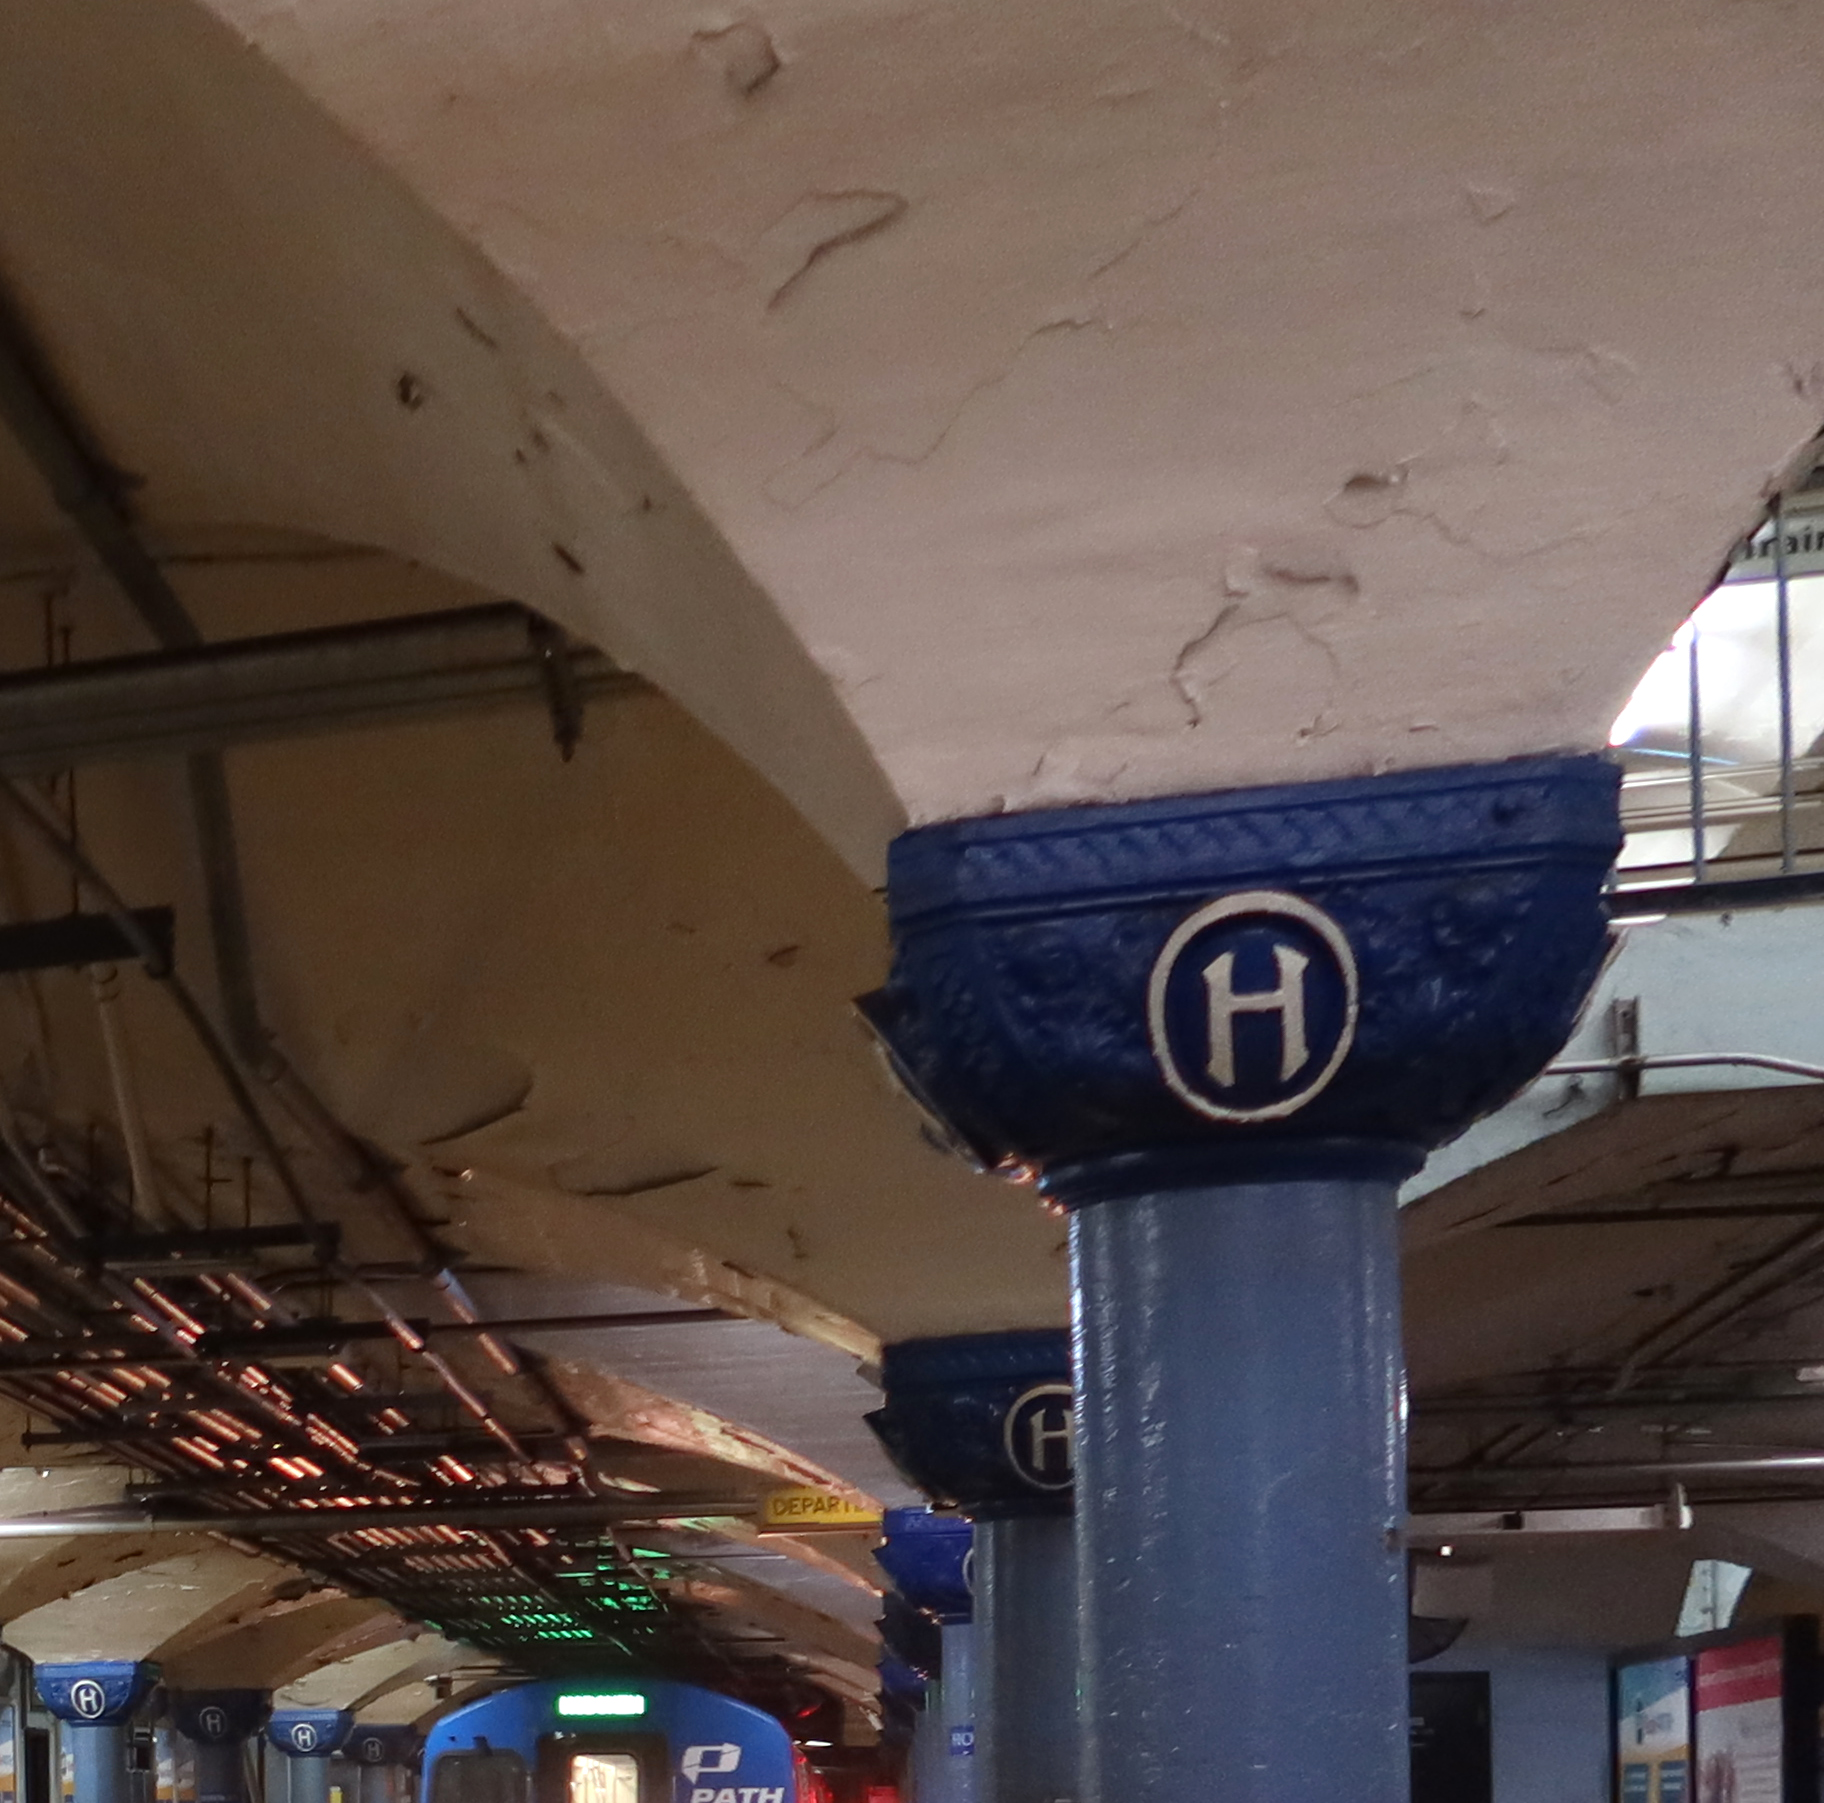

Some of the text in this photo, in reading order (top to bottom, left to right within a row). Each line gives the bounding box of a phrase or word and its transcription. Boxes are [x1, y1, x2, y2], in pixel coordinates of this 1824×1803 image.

[1202, 944, 1310, 1088] H
[773, 1496, 864, 1515] DEPAR
[79, 1688, 98, 1712] H
[298, 1729, 311, 1746] H
